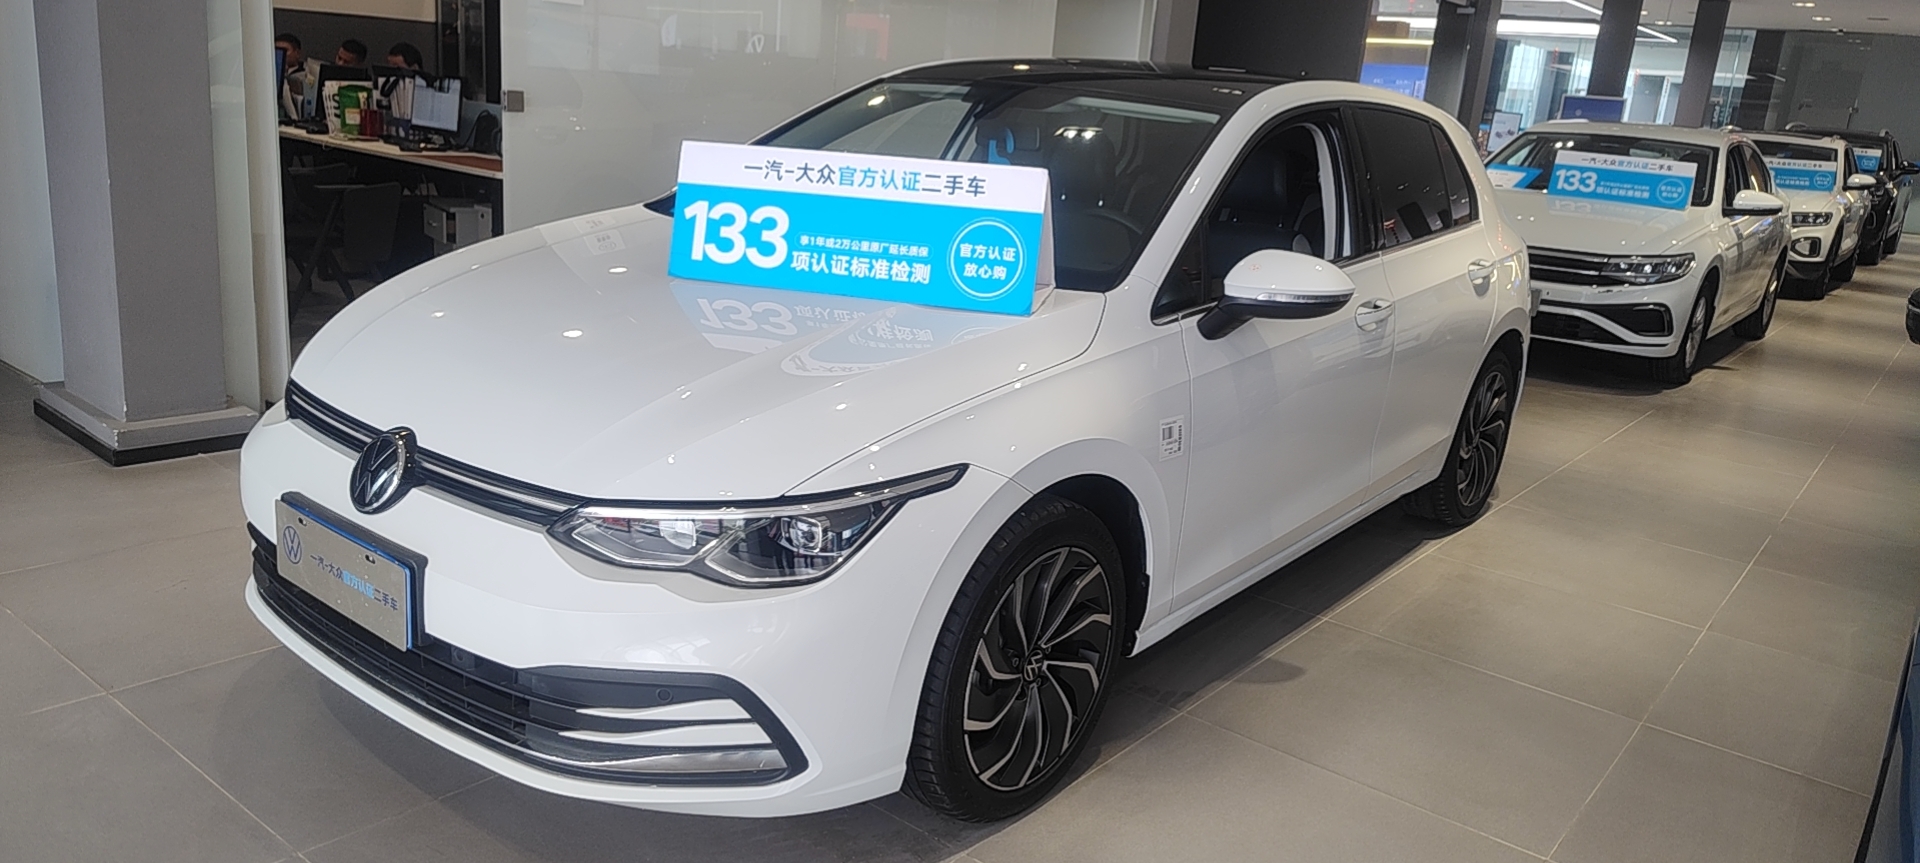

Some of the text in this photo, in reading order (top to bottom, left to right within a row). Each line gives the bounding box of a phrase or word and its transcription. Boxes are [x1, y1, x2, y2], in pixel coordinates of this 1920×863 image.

[1555, 168, 1598, 193] 133
[684, 199, 791, 269] 133
[959, 242, 1017, 263] 官方认证
[790, 250, 932, 285] 项认证标准检测
[963, 262, 1008, 281] 放心购
